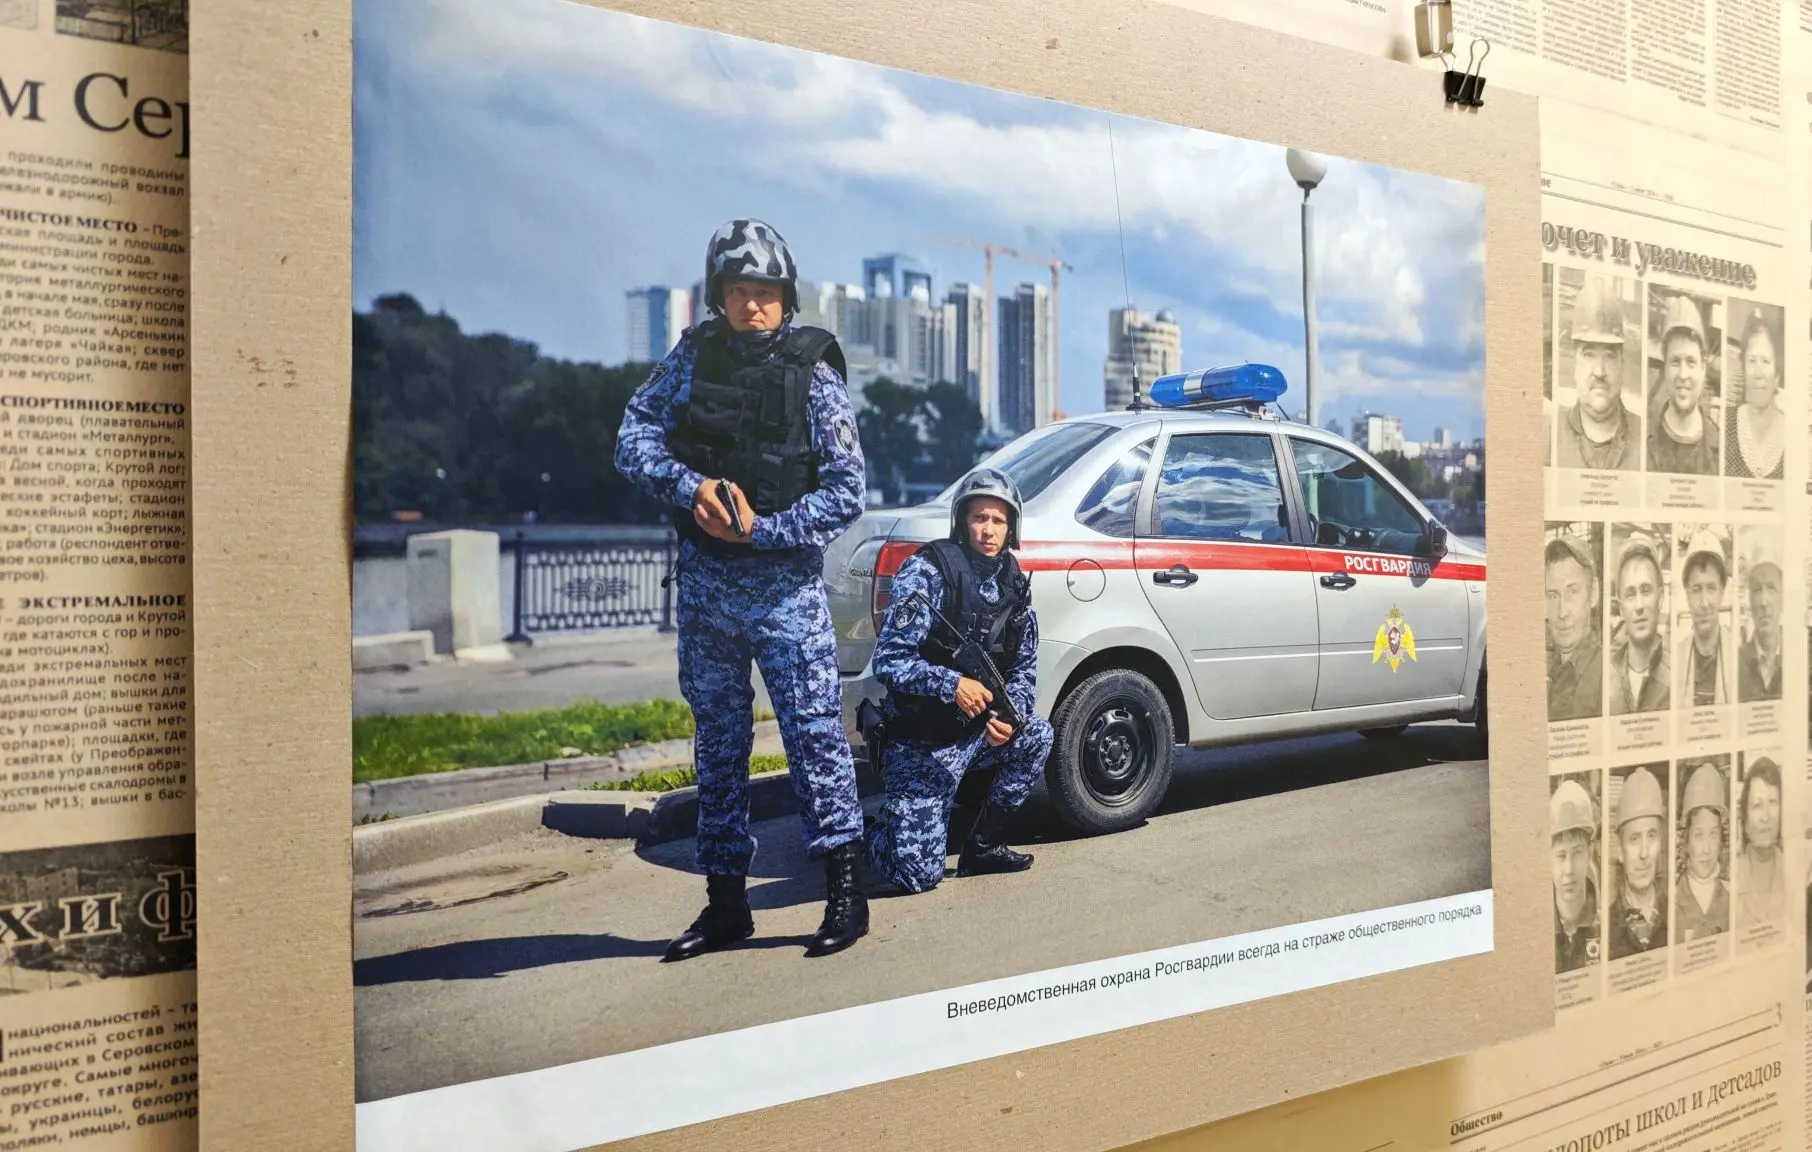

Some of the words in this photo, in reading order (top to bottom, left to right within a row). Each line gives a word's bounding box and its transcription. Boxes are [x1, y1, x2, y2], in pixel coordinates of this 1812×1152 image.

[1610, 235, 1630, 263] и
[1634, 239, 1757, 290] уважение
[1343, 555, 1432, 577] РОСГВАРДИЯ
[19, 594, 186, 610] ЭКСТРЕМАЛЬНОЕ
[138, 609, 185, 625] Крутой
[58, 763, 144, 779] управления
[946, 976, 1096, 1019] Вневедомственная
[1100, 966, 1150, 989] охрана
[1155, 948, 1235, 978] Росгвардии
[1238, 943, 1281, 962] всегда
[1284, 938, 1299, 951] на
[1302, 928, 1346, 950] страже
[1348, 912, 1436, 940] общественного
[1438, 903, 1482, 924] порядка
[8, 1005, 160, 1040] национальностей
[9, 1033, 97, 1058] нический
[106, 1026, 164, 1044] состав
[102, 1038, 195, 1062] Серовском
[75, 1063, 133, 1084] Самые
[1706, 1059, 1783, 1110] детсадов
[1450, 1110, 1503, 1136] Общество
